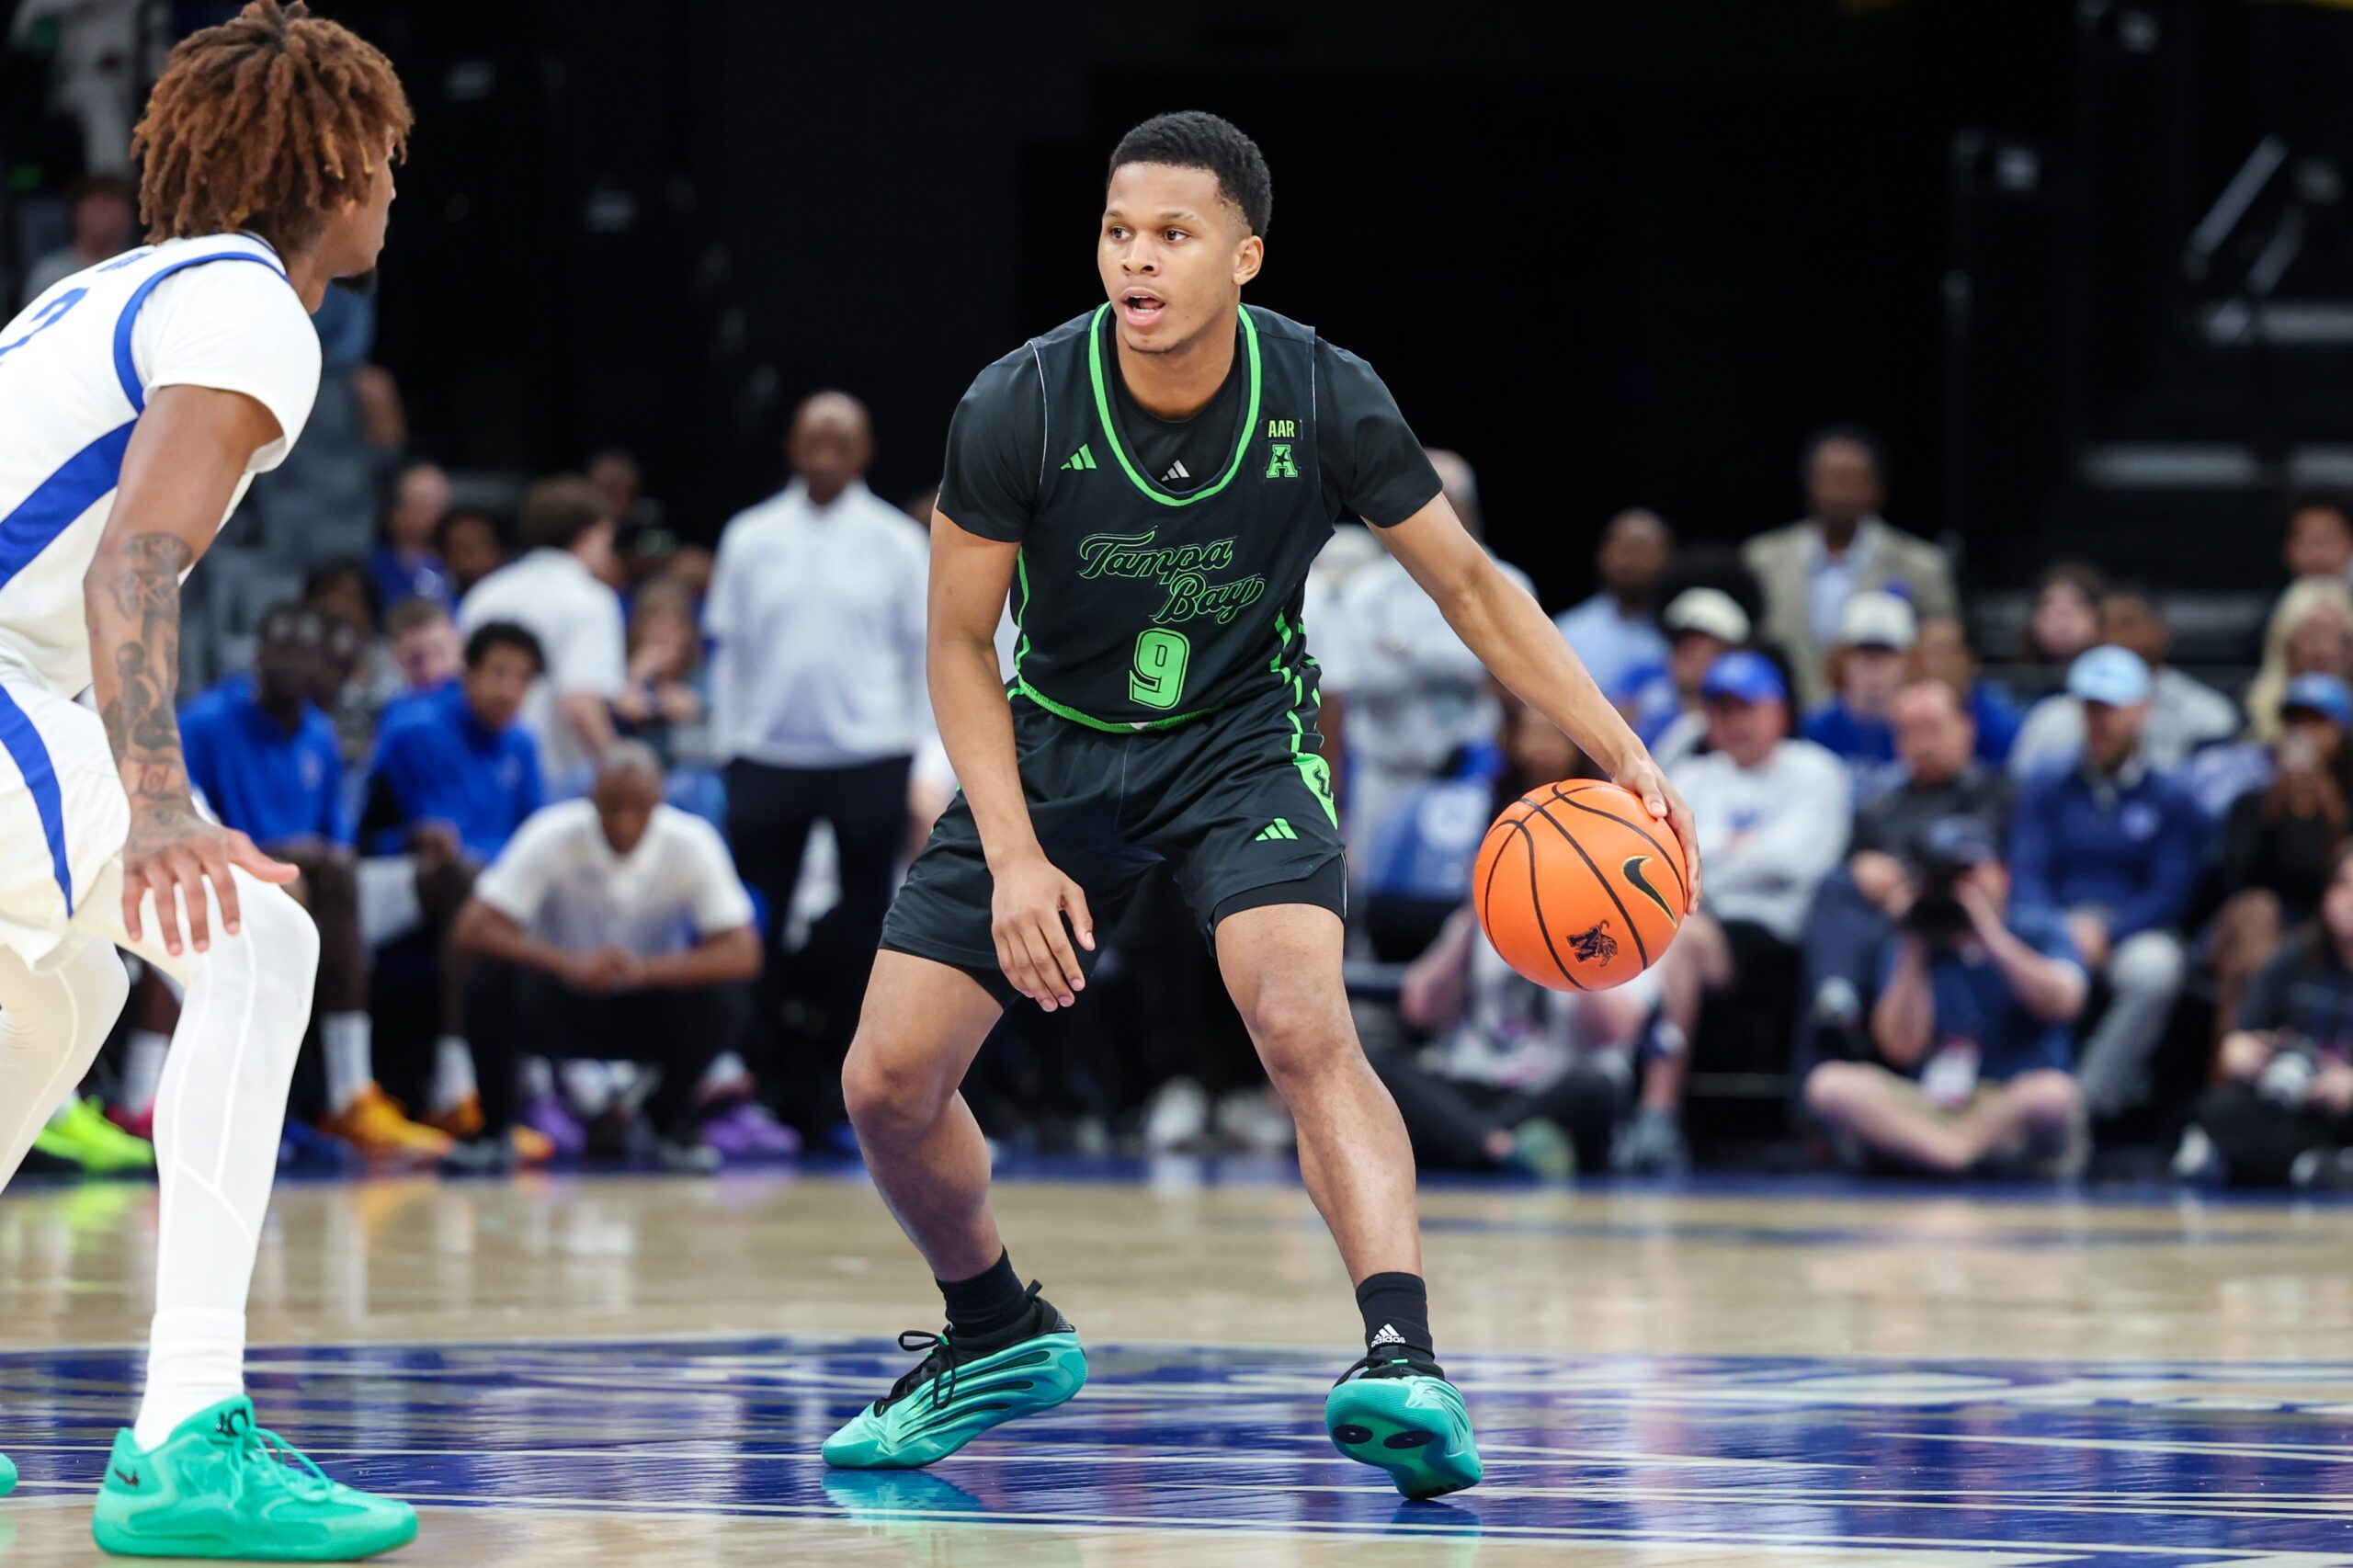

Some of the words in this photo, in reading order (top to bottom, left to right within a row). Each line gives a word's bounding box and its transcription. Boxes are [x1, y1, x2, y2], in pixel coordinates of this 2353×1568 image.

[1267, 419, 1296, 438] AAR
[1266, 444, 1299, 479] A
[1076, 525, 1239, 585] Tampa
[1149, 573, 1267, 625] Bay
[1129, 627, 1191, 710] 9
[1370, 1335, 1406, 1348] adidas
